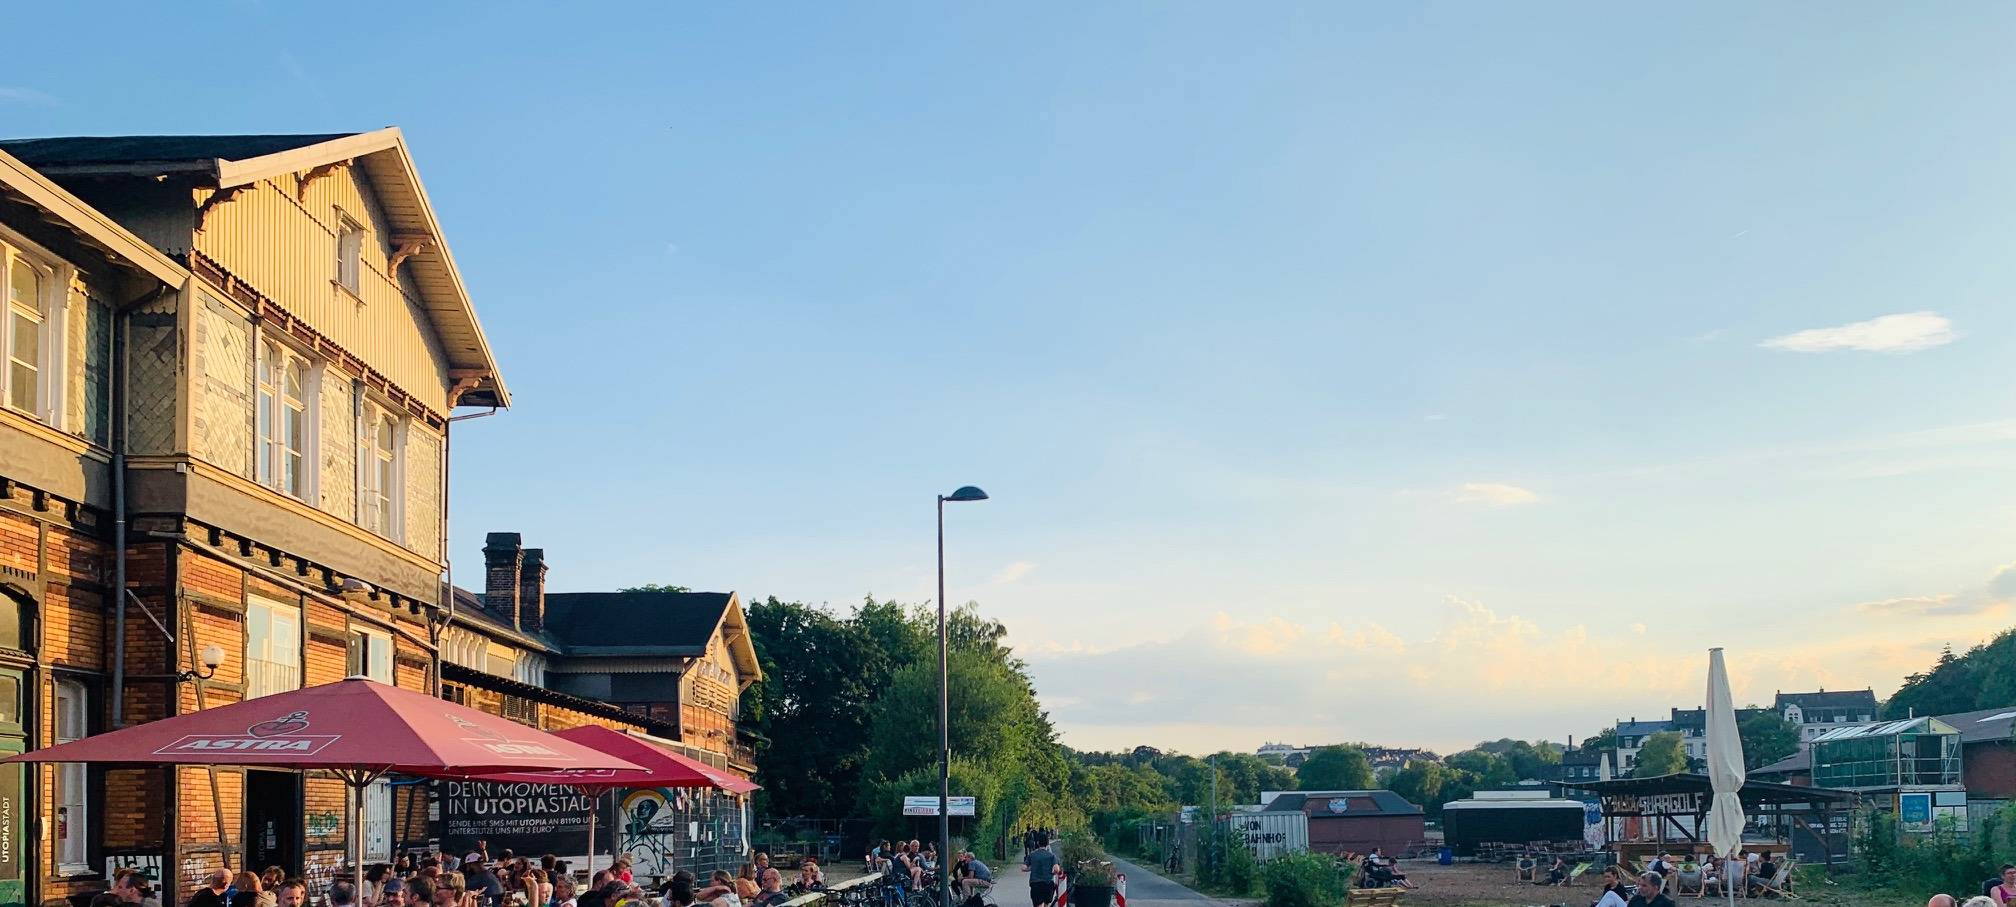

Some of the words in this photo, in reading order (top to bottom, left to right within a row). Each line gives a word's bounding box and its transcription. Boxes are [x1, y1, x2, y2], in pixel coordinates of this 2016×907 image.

[177, 740, 313, 750] ASTRA
[449, 781, 491, 797] DEIN
[498, 783, 575, 797] MOMEN
[449, 799, 468, 814] IN
[449, 820, 471, 828] SENDE
[489, 819, 505, 827] SMS
[506, 819, 519, 827] MIT
[519, 818, 547, 826] UTOPIA
[560, 817, 582, 825] 81190
[2, 797, 10, 863] UTOPIASTADT
[495, 826, 511, 834] UNS
[512, 826, 525, 834] MIT
[526, 826, 531, 834] 3
